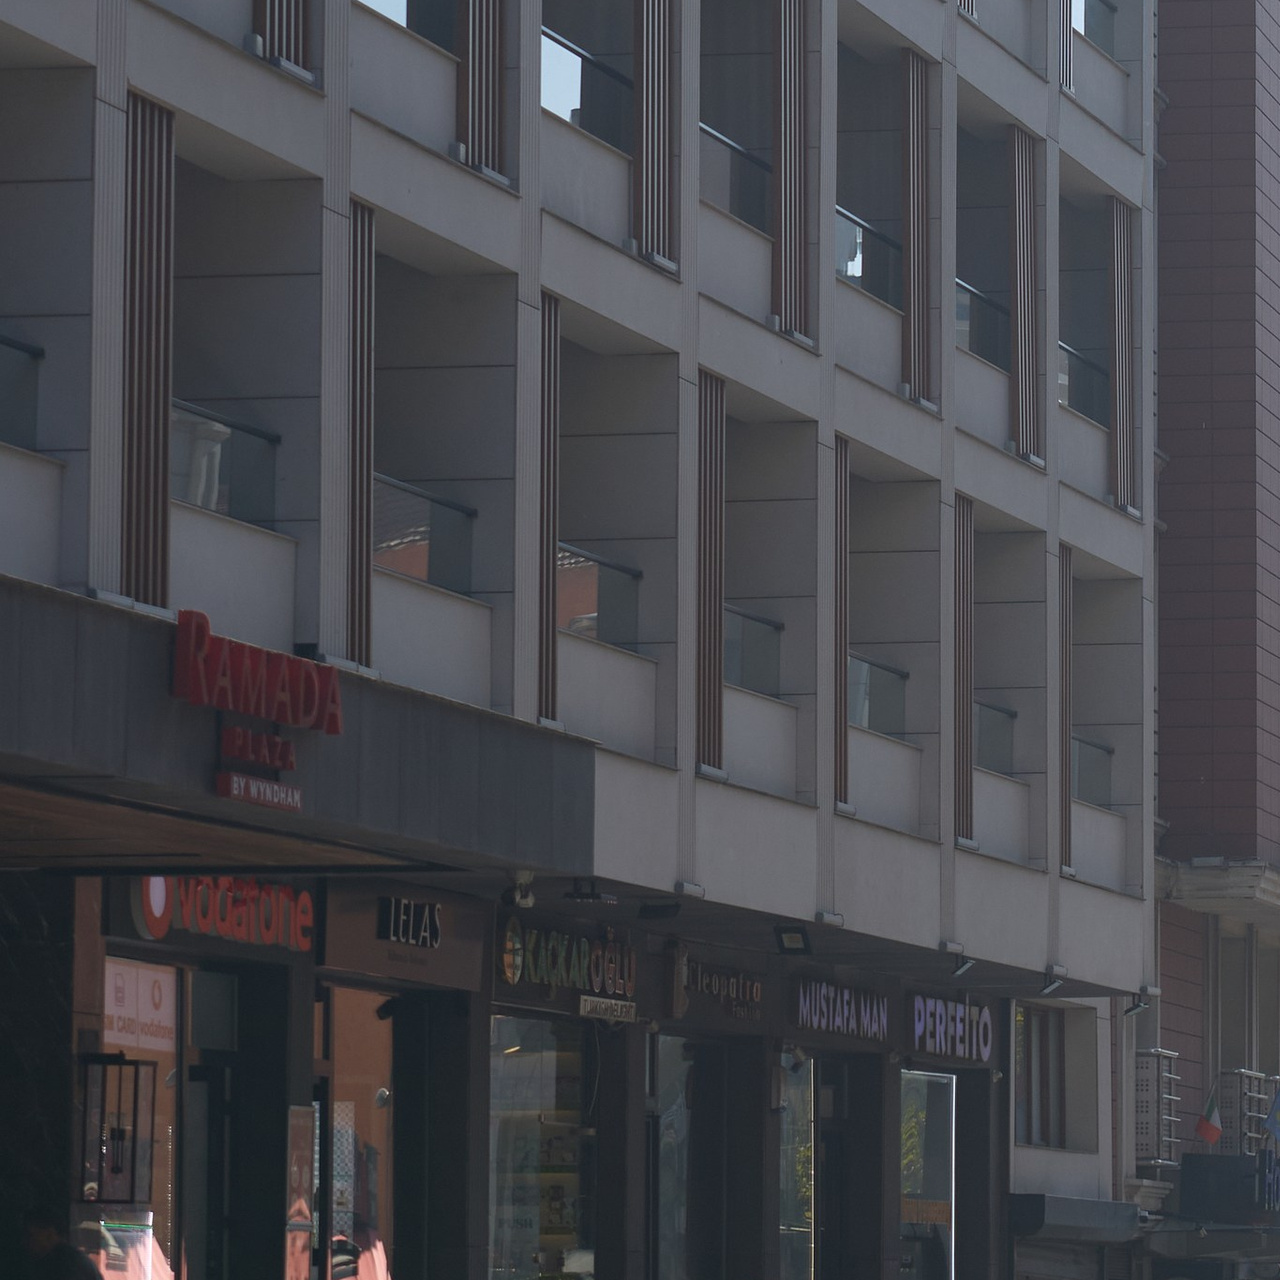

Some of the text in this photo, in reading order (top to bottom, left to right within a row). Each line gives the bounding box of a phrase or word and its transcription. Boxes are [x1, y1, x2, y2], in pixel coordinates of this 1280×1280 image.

[182, 610, 343, 735] RAMADA
[226, 727, 296, 769] PLAZA
[232, 775, 301, 808] BY WYNDHAM
[177, 876, 314, 951] vodafone
[390, 897, 442, 949] LELAS
[690, 963, 763, 1003] Cleopatra
[799, 978, 888, 1042] MUSTAFA MAN
